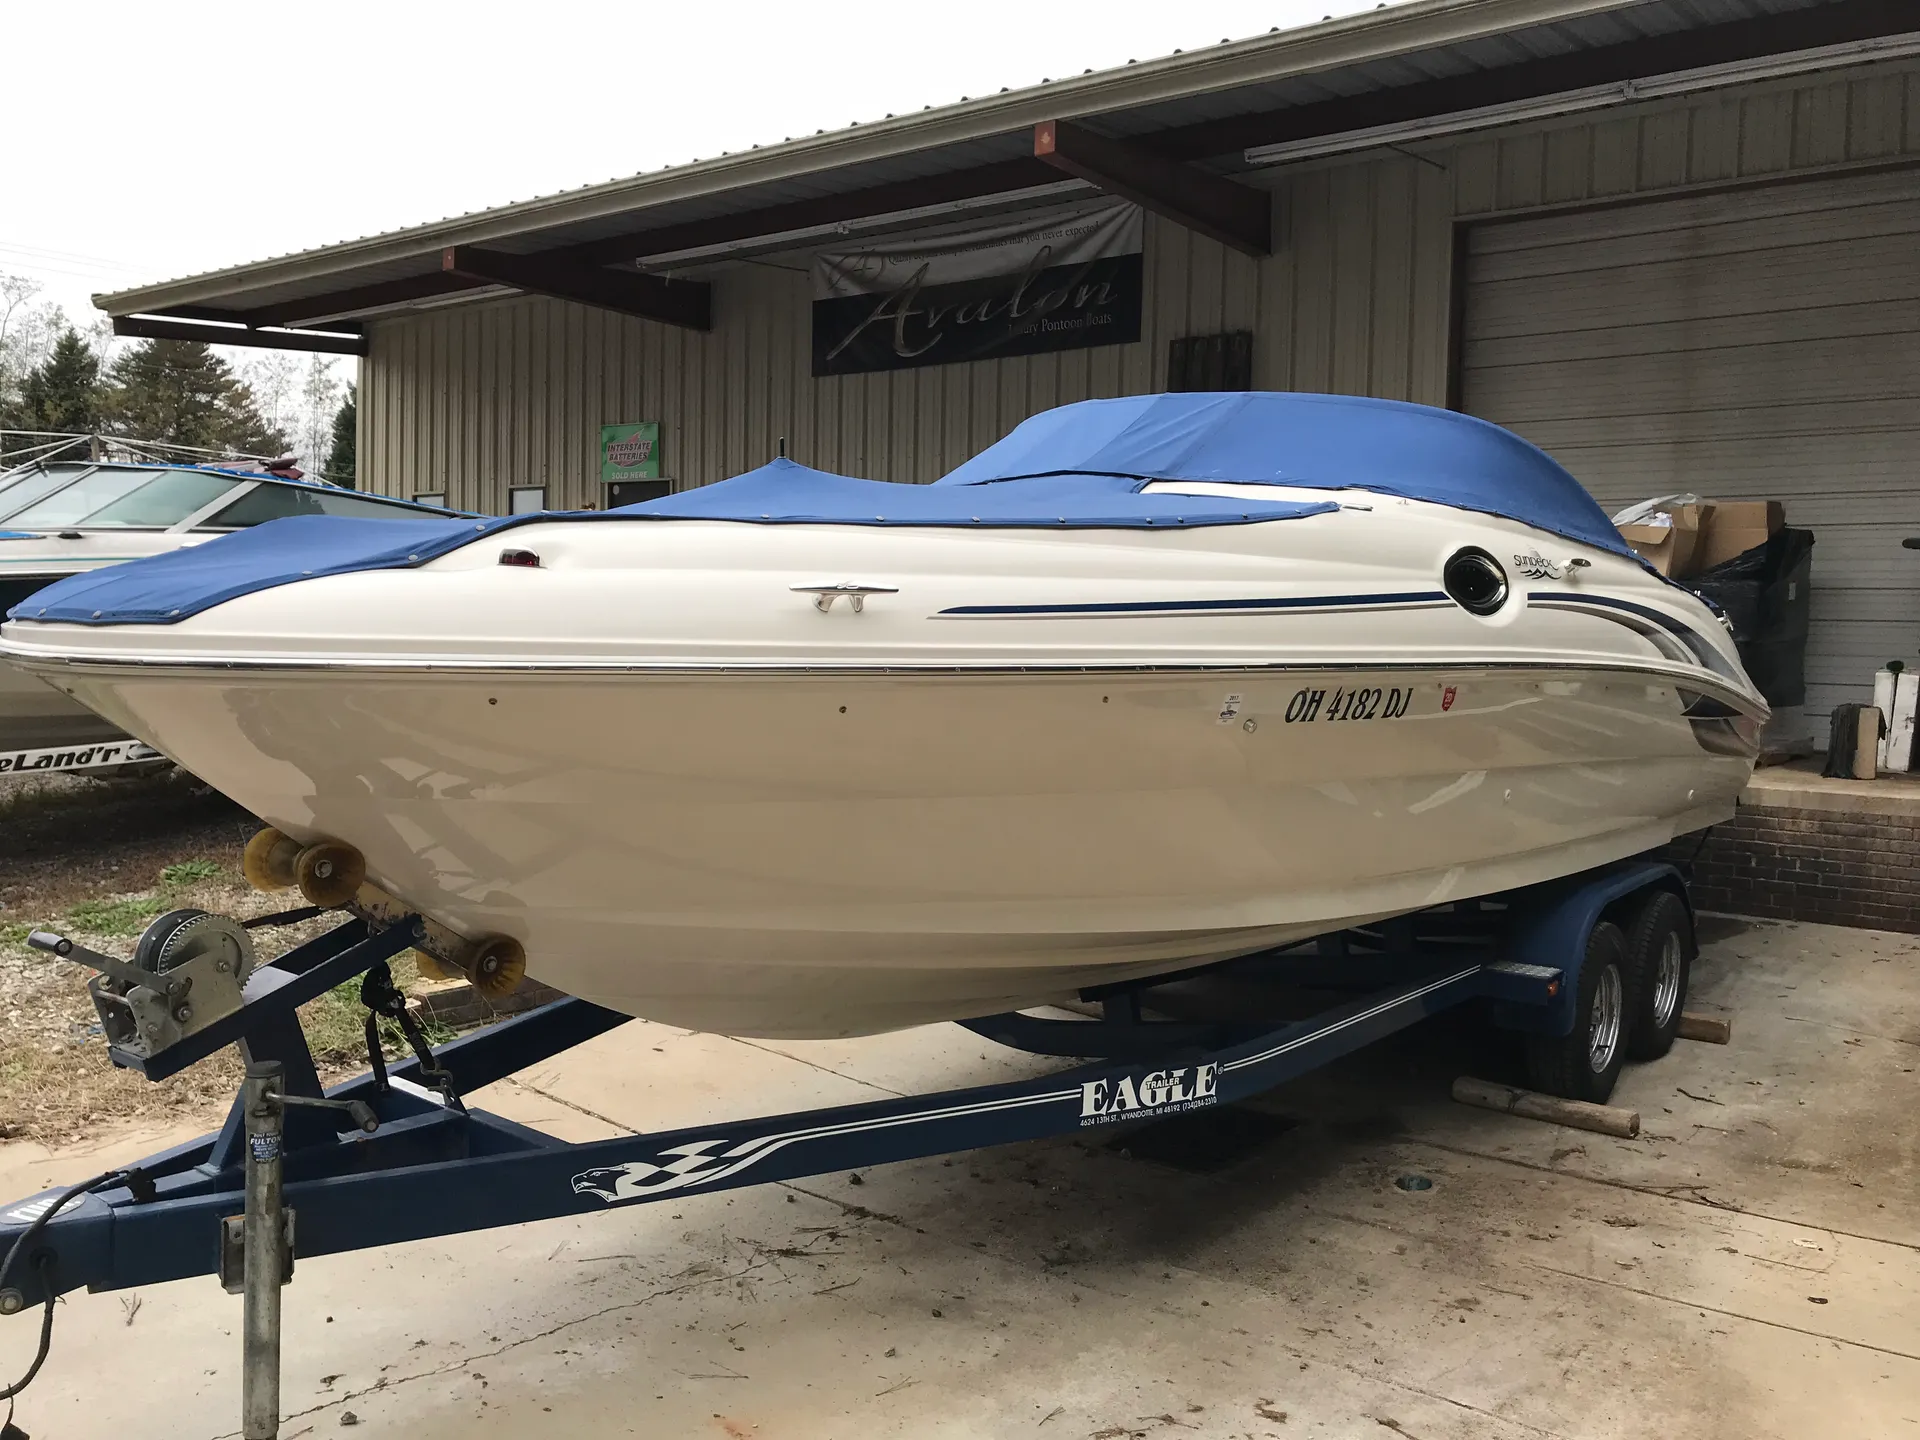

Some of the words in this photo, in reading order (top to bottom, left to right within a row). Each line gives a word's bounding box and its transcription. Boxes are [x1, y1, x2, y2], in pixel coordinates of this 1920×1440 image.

[1026, 232, 1041, 245] you
[1042, 230, 1063, 241] never
[826, 245, 1118, 360] Avalon
[1041, 318, 1083, 333] Pontoon
[1086, 312, 1112, 328] Boats
[608, 442, 651, 452] INTERSTATE
[609, 452, 648, 461] BATTERIES
[611, 472, 629, 480] SOLD
[630, 471, 648, 479] HERE
[1284, 689, 1326, 724] OH
[1325, 686, 1382, 721] 4182
[1380, 687, 1414, 719] DJ
[1146, 1077, 1180, 1090] TRAILER
[1079, 1117, 1096, 1127] 4624
[1096, 1114, 1110, 1125] 13TH
[1163, 1103, 1181, 1114] 48192
[250, 1135, 281, 1145] FULTON
